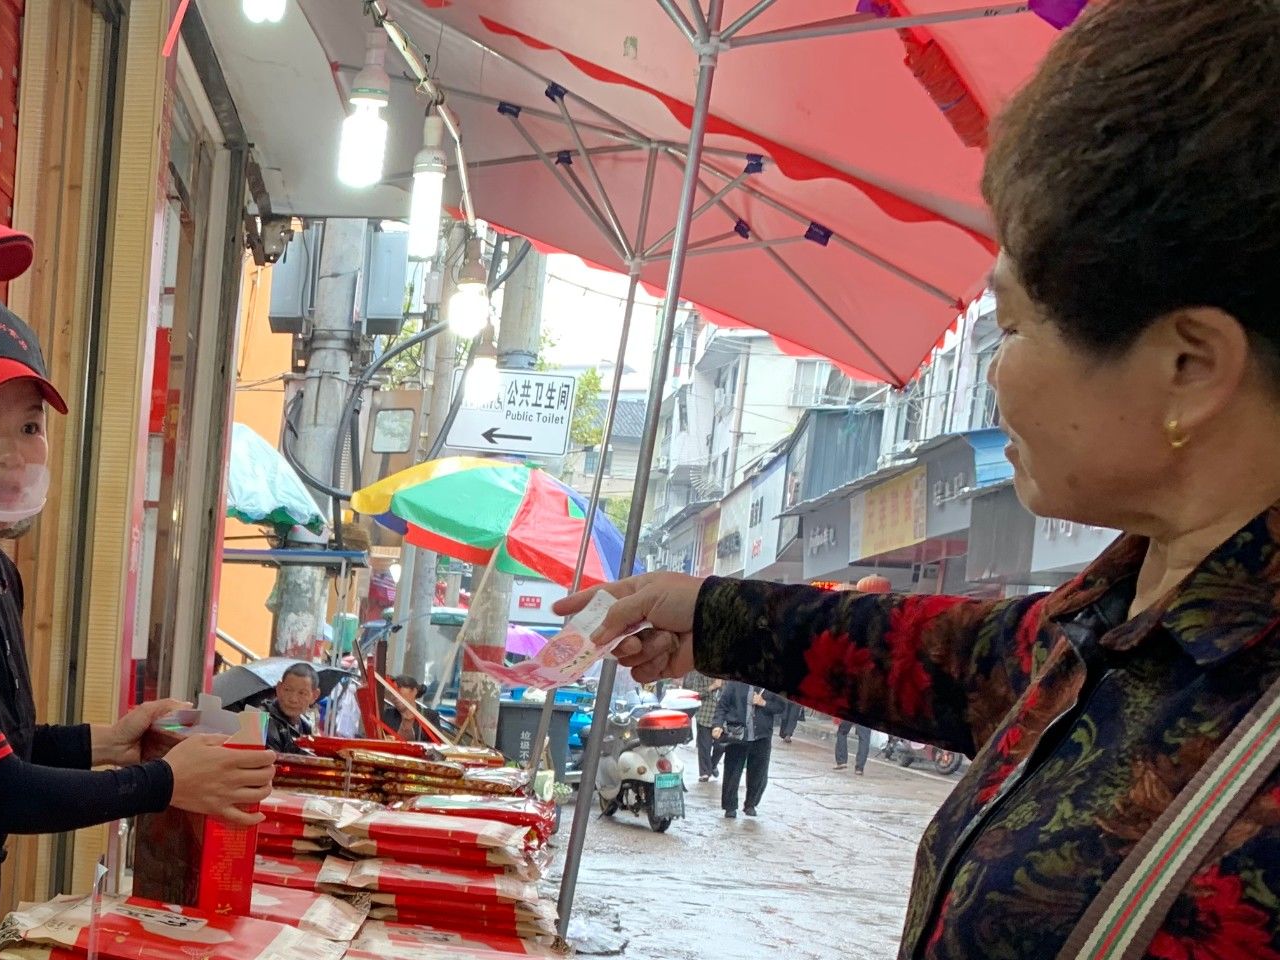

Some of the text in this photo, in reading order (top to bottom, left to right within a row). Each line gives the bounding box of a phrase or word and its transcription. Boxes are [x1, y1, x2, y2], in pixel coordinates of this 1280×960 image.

[506, 379, 571, 410] 公共卫生间
[505, 410, 564, 424] Public Toilet
